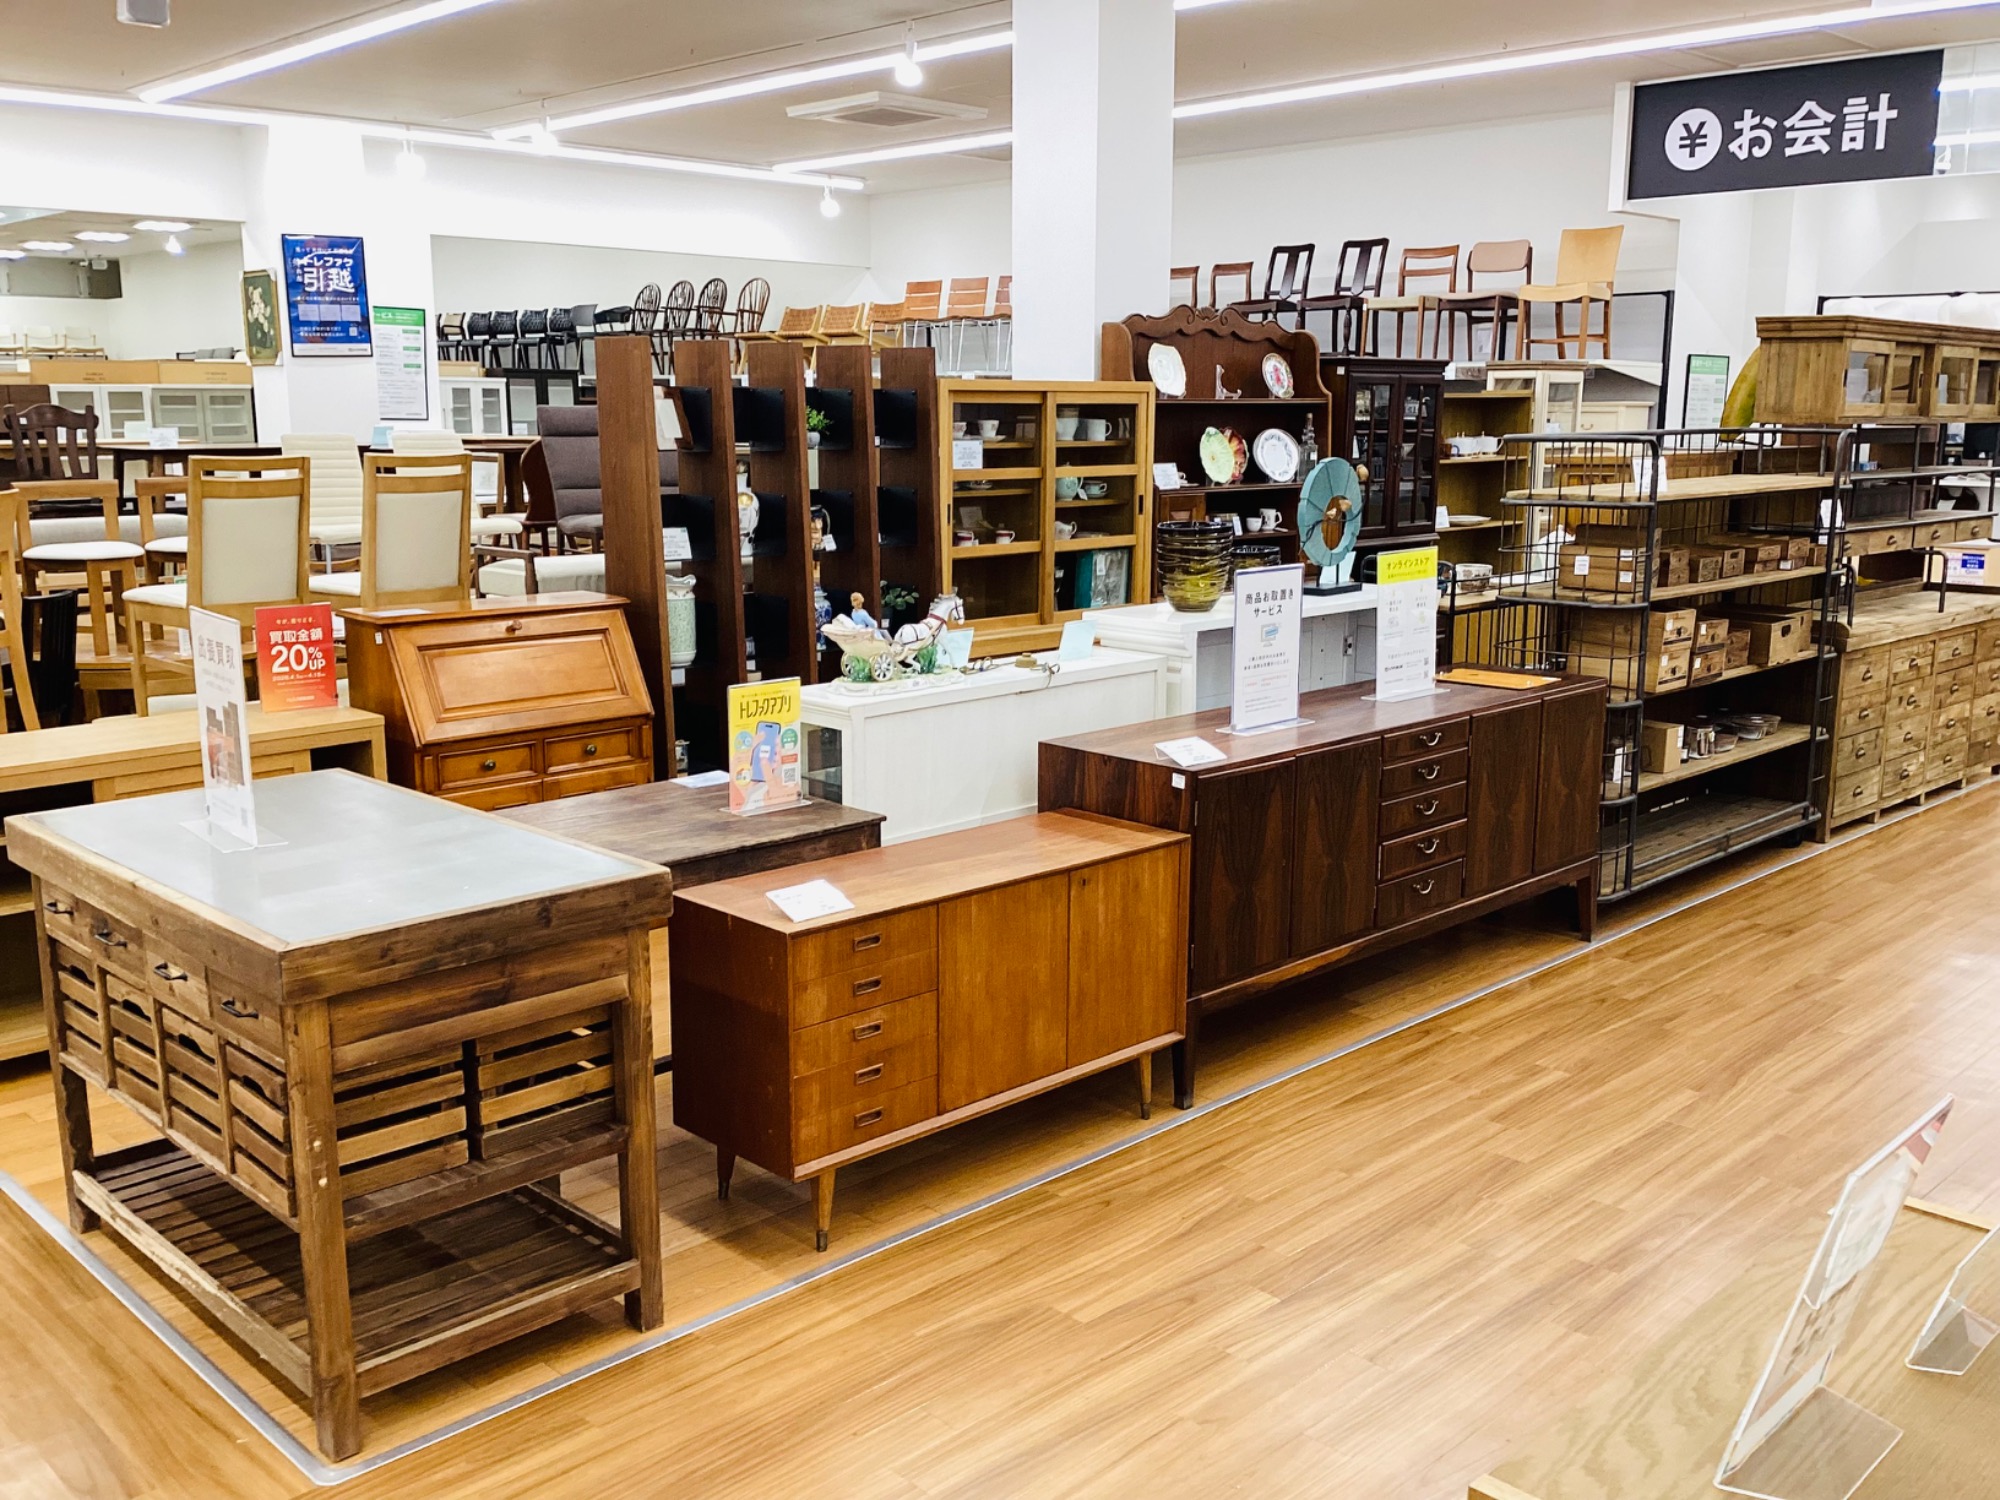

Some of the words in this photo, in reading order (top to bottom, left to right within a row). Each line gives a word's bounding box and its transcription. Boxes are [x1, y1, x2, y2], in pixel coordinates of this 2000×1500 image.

[1728, 92, 1898, 161] お会計
[303, 267, 355, 293] 引越
[1386, 557, 1430, 570] オンラインストア
[1245, 588, 1294, 605] 商品お取置き
[1253, 604, 1283, 618] サービス
[269, 627, 323, 644] 買取金額
[308, 659, 326, 670] UP
[739, 694, 792, 719] トレファクアプリ
